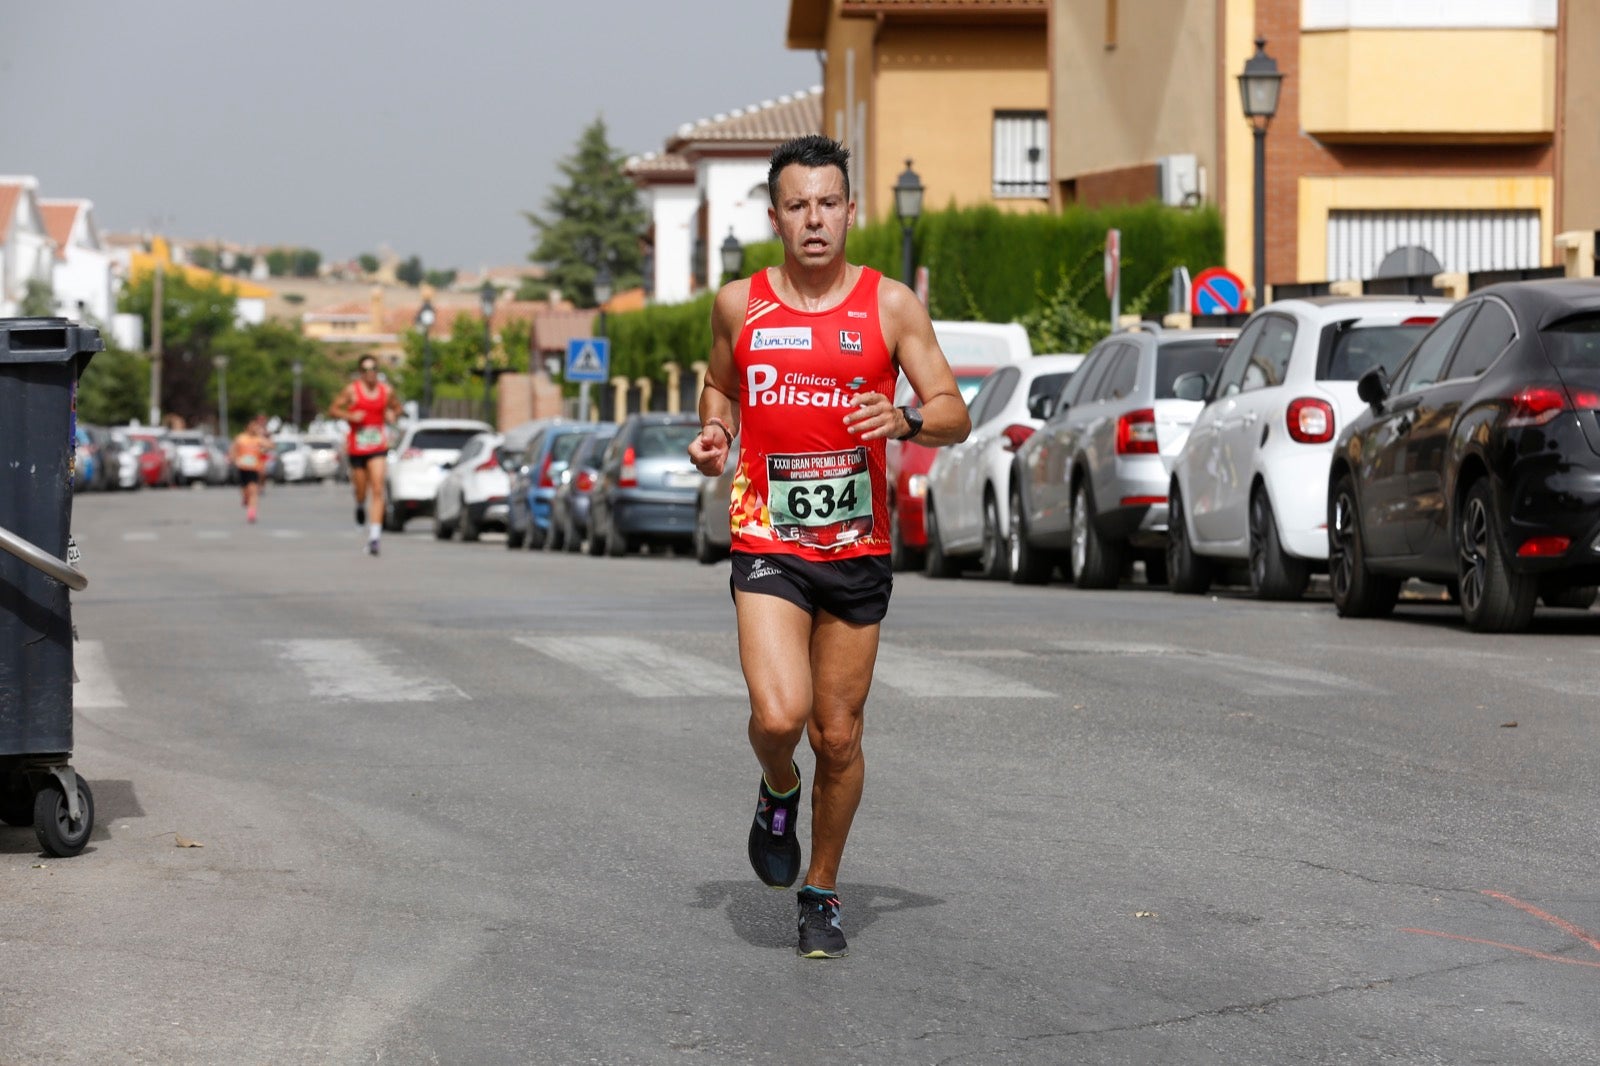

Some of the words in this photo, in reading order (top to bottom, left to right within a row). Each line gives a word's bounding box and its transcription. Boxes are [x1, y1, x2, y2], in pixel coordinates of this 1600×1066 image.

[841, 331, 846, 342] I
[841, 342, 861, 350] MOVE
[746, 363, 862, 408] Polisalu
[784, 372, 837, 387] Clínicas
[791, 457, 810, 470] GRAN
[811, 455, 836, 469] PREMIO
[837, 454, 846, 467] DE
[787, 479, 858, 519] 634
